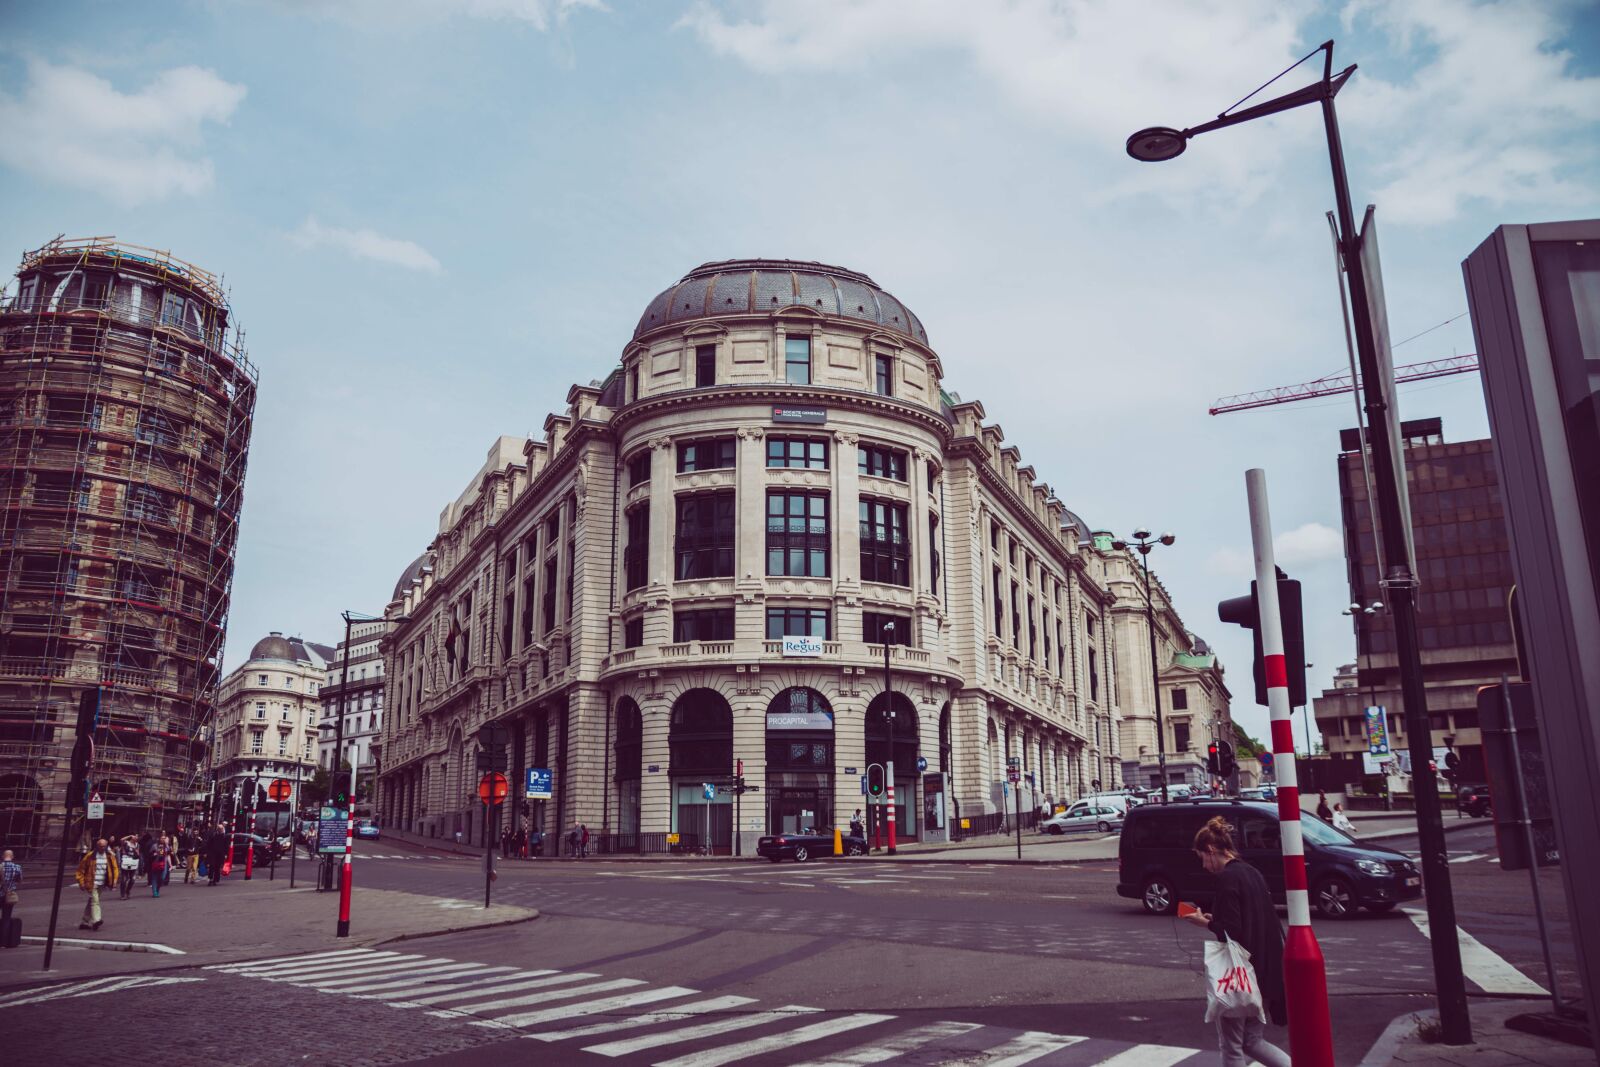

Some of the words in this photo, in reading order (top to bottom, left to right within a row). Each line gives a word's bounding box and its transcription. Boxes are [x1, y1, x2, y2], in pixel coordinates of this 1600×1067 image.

[786, 641, 821, 653] Regus
[768, 717, 809, 725] PROCAPITAL
[530, 771, 539, 784] P
